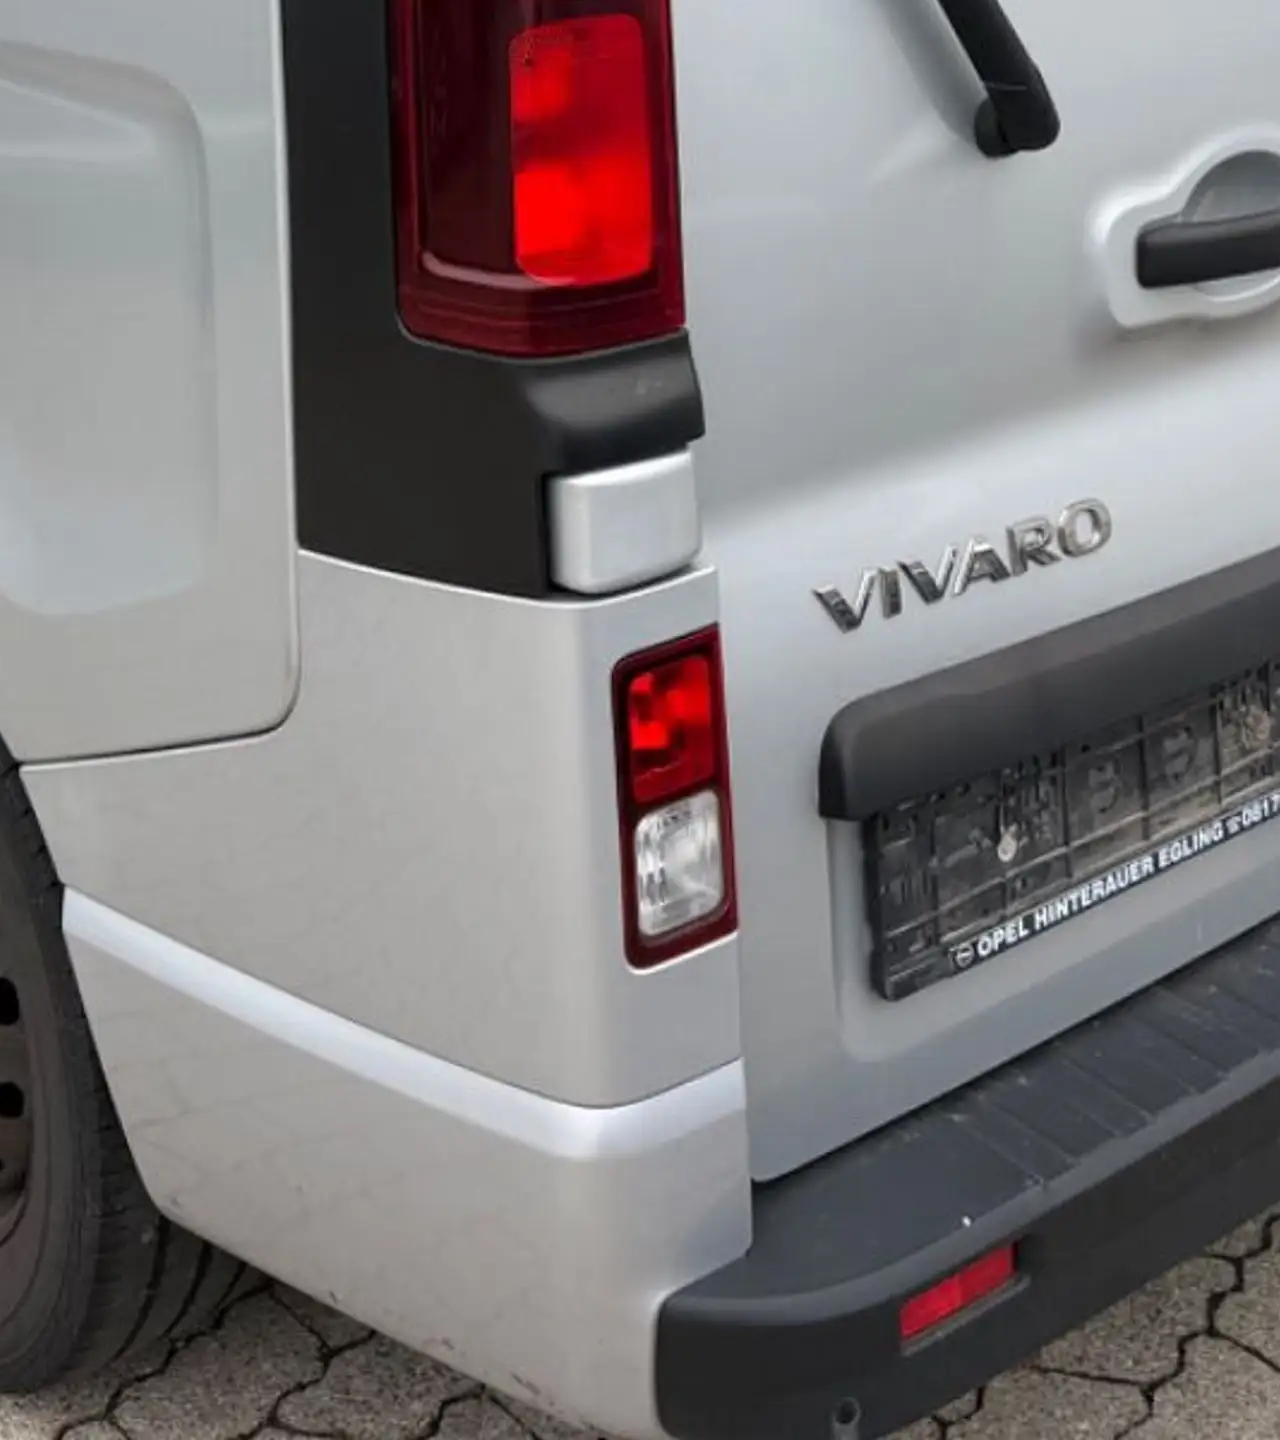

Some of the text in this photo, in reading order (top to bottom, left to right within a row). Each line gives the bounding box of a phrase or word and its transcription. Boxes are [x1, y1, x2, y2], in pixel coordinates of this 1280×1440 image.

[812, 498, 1112, 634] VIVARO
[977, 920, 1030, 958] OPEL
[1034, 854, 1155, 932] HINTERAUER
[1158, 818, 1224, 869] EGLING
